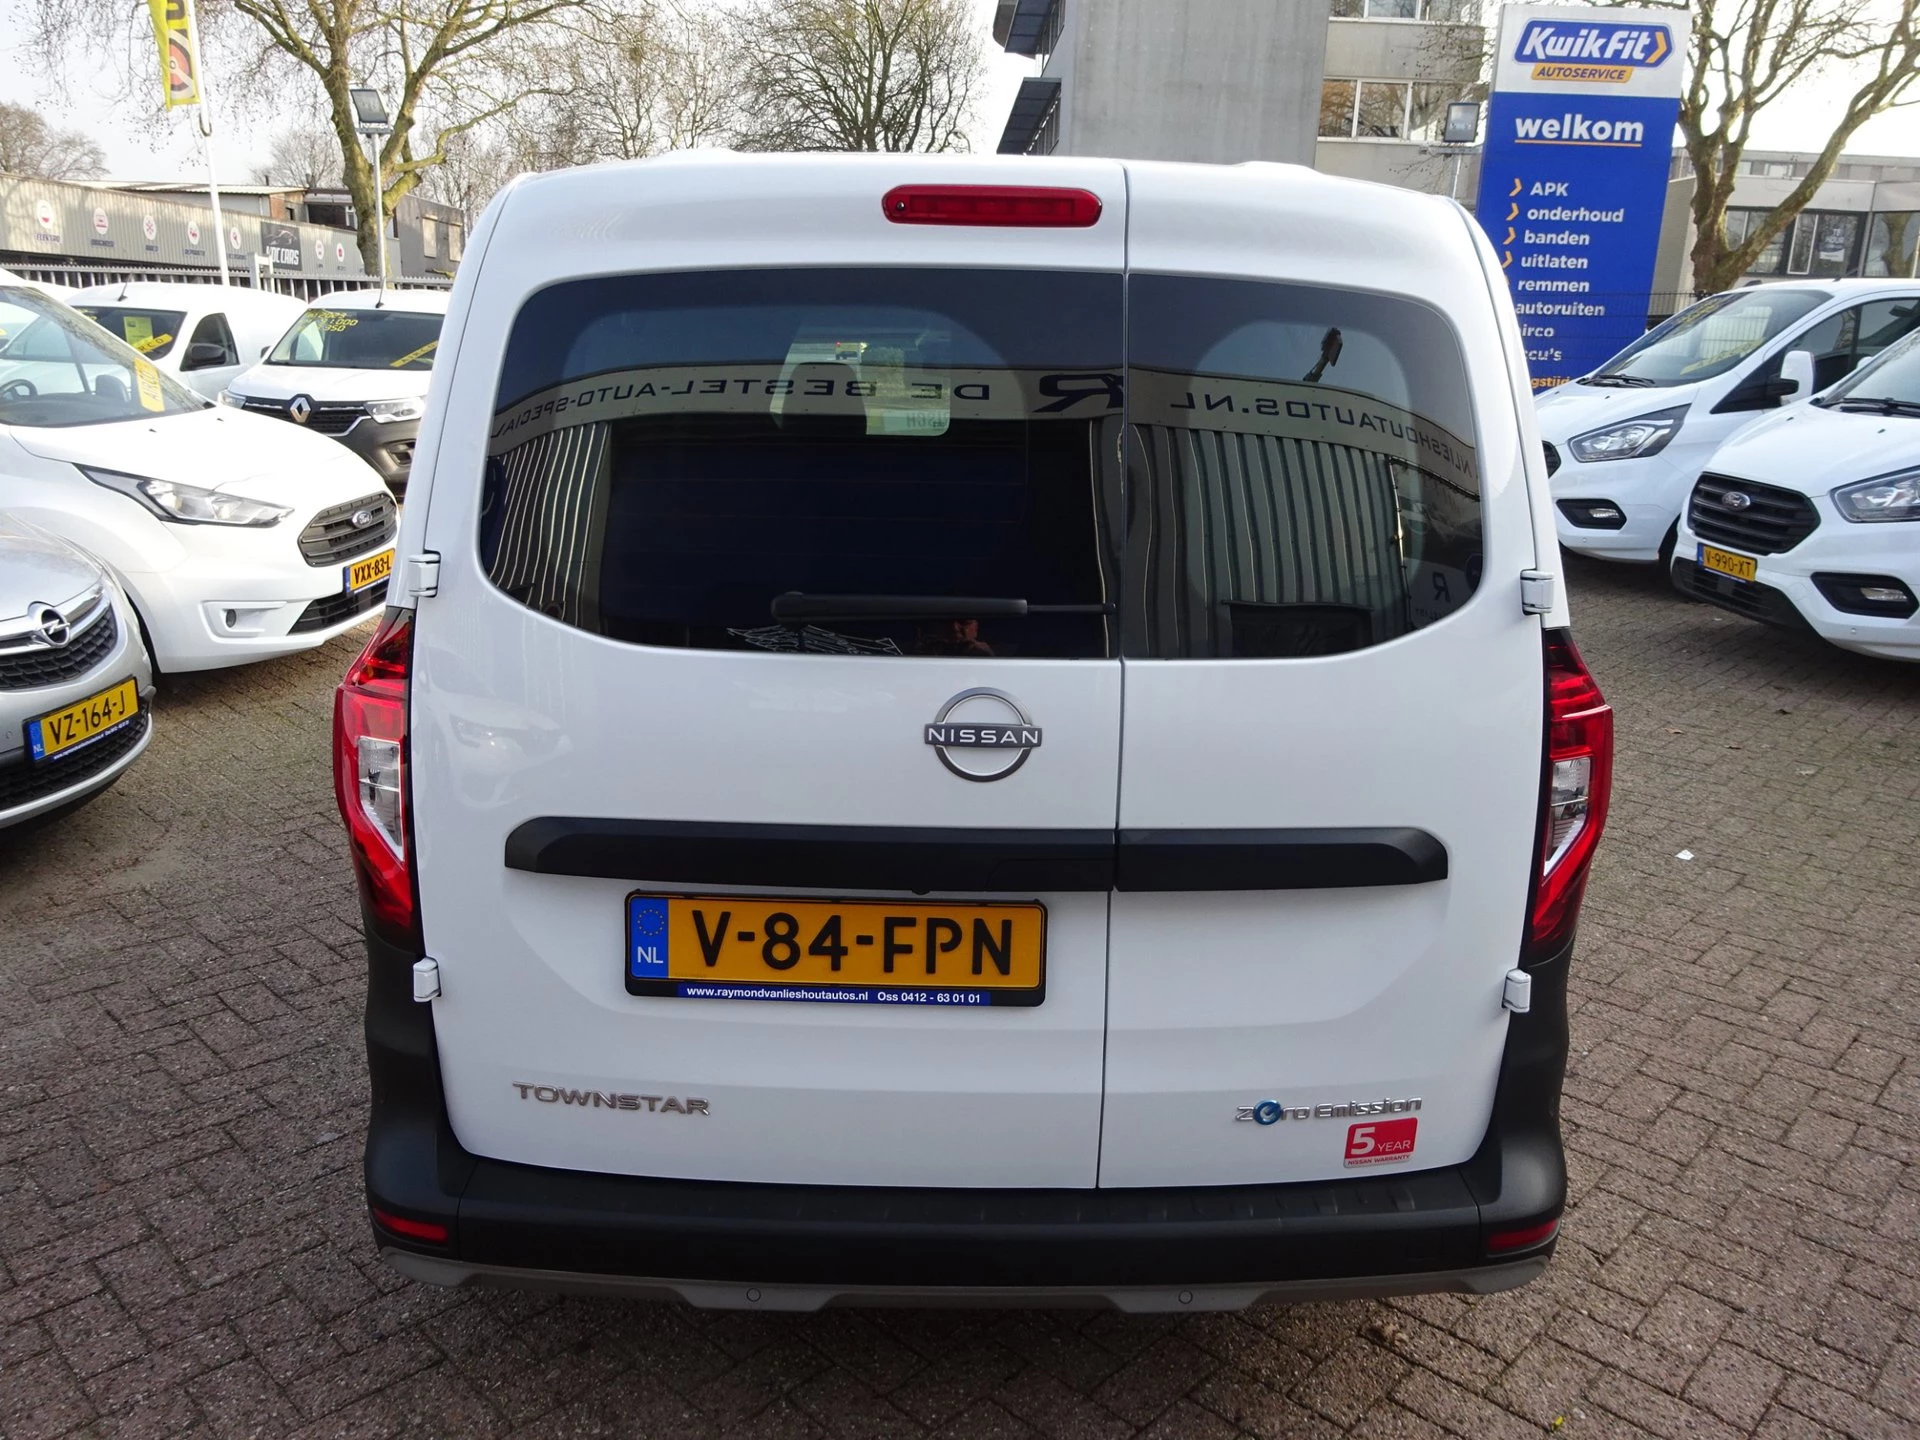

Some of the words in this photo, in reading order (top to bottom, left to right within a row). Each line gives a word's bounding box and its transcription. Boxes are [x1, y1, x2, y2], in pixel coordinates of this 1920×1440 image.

[1537, 67, 1627, 80] AUTOSERVICE
[1515, 113, 1644, 142] welkom
[1529, 181, 1569, 197] APK
[1527, 206, 1625, 223] onderhoud
[1523, 229, 1591, 246] banden
[1521, 253, 1589, 269] uitlaten
[1517, 279, 1590, 293] remmen
[1516, 301, 1606, 317] autoruiten
[1520, 323, 1555, 338] irco
[138, 338, 164, 352] RCO
[1525, 347, 1563, 362] cu's
[353, 554, 392, 585] VXX-83-L
[1704, 549, 1752, 577] V-990-XT
[48, 690, 125, 745] VZ-164-J
[927, 727, 1040, 745] NISSAN
[637, 946, 664, 964] NL
[692, 909, 1012, 976] V-84-FPN
[686, 987, 869, 1002] www.raymondvanlieshoutautos.nl
[877, 991, 899, 1001] Oss
[901, 992, 927, 1002] 0412
[937, 993, 950, 1003] 63
[953, 993, 965, 1003] 01
[968, 994, 980, 1004] 01
[512, 1080, 710, 1117] TOWNSTAR
[1314, 1097, 1422, 1118] Emission
[1350, 1126, 1376, 1155] 5
[1377, 1139, 1411, 1152] YEAR
[1348, 1158, 1372, 1166] NISSAN
[1374, 1154, 1410, 1164] WARRANTY
